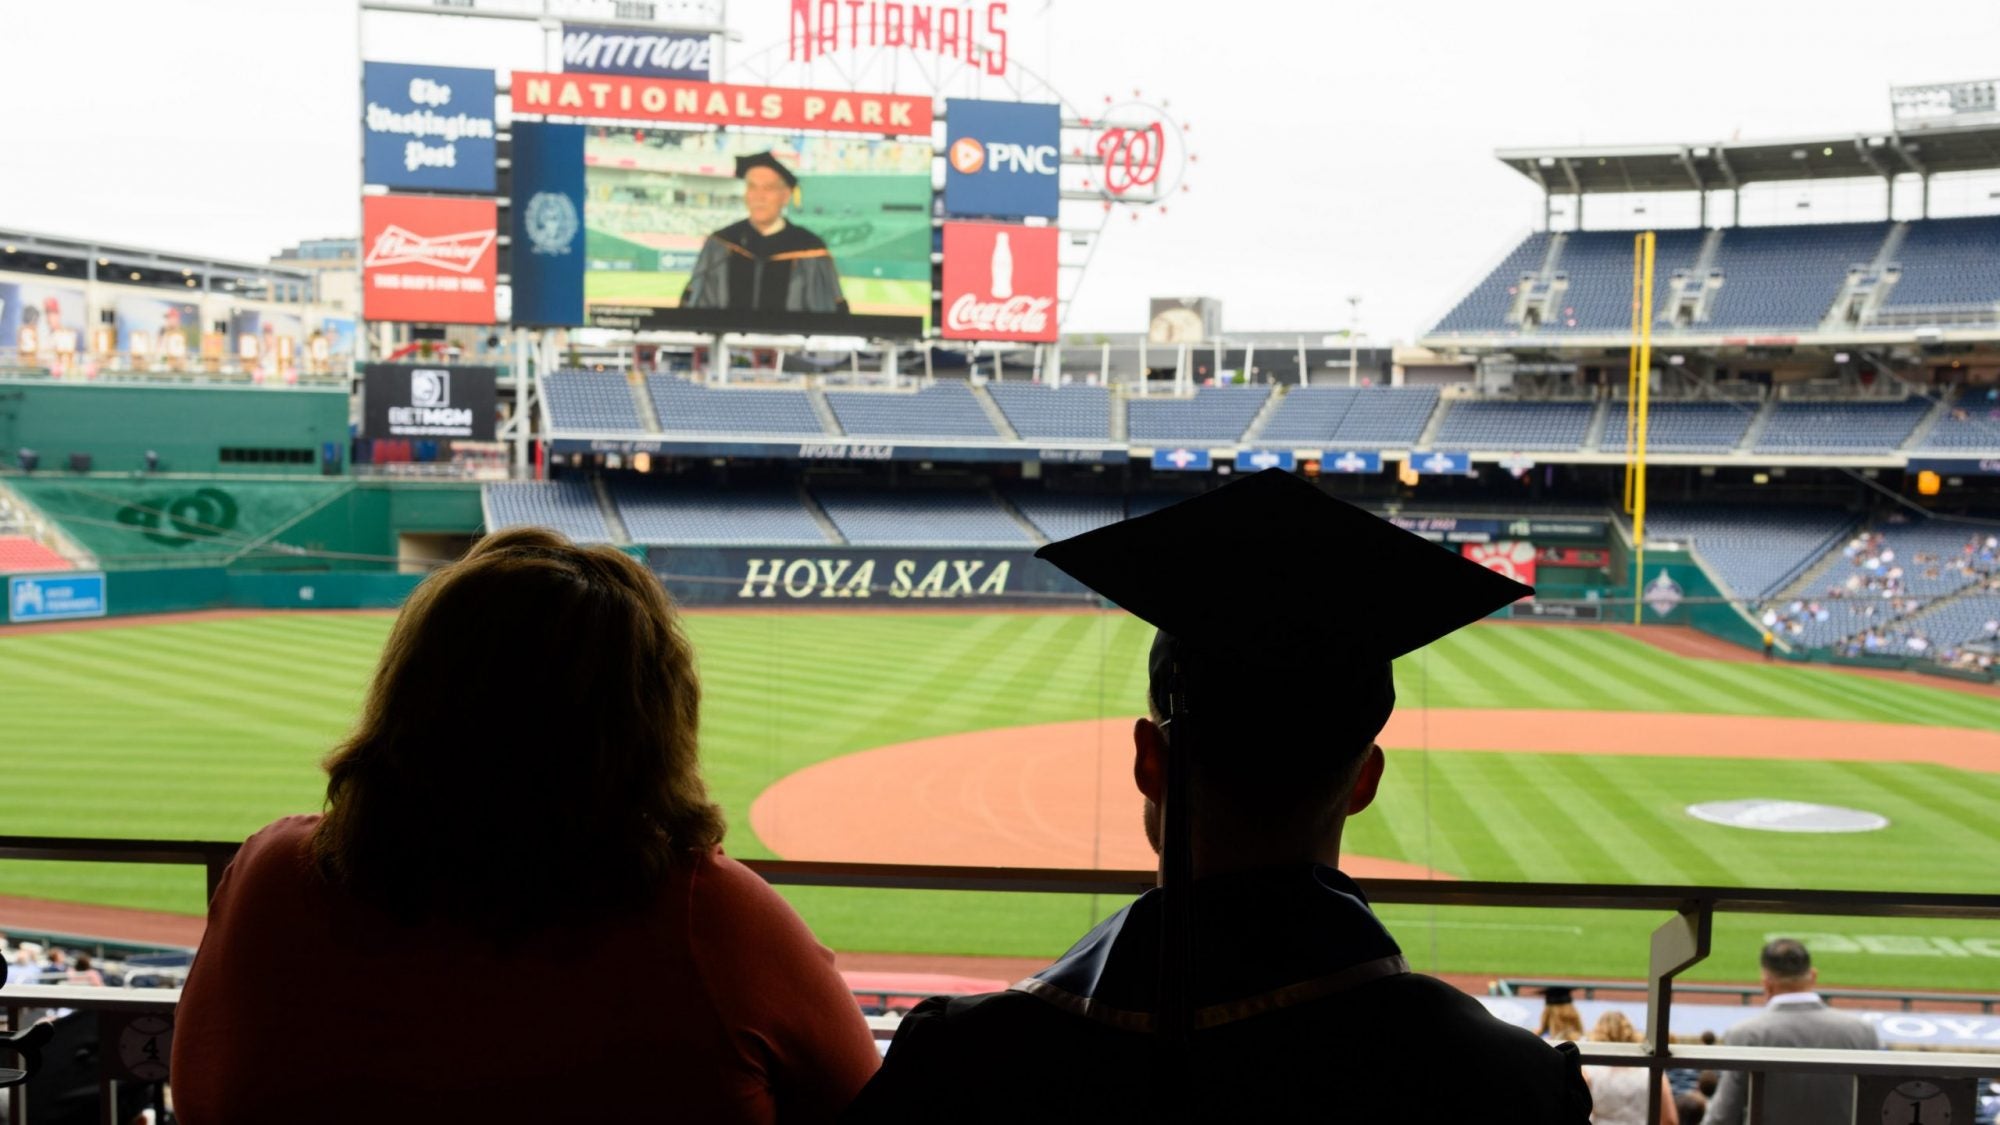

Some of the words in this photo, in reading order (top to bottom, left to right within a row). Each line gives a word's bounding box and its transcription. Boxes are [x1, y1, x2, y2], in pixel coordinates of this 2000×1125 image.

[562, 32, 710, 71] NATITUDE
[790, 0, 1006, 75] NATIONALS
[409, 78, 451, 107] The
[526, 80, 783, 119] NATIONALS
[804, 95, 912, 126] PARK
[367, 102, 493, 141] Washington
[404, 141, 456, 171] Post
[987, 142, 1057, 174] PNC
[739, 558, 875, 598] HOYA
[889, 559, 1012, 598] SAXA
[143, 1036, 160, 1061] 4
[1908, 1101, 1925, 1125] 1
